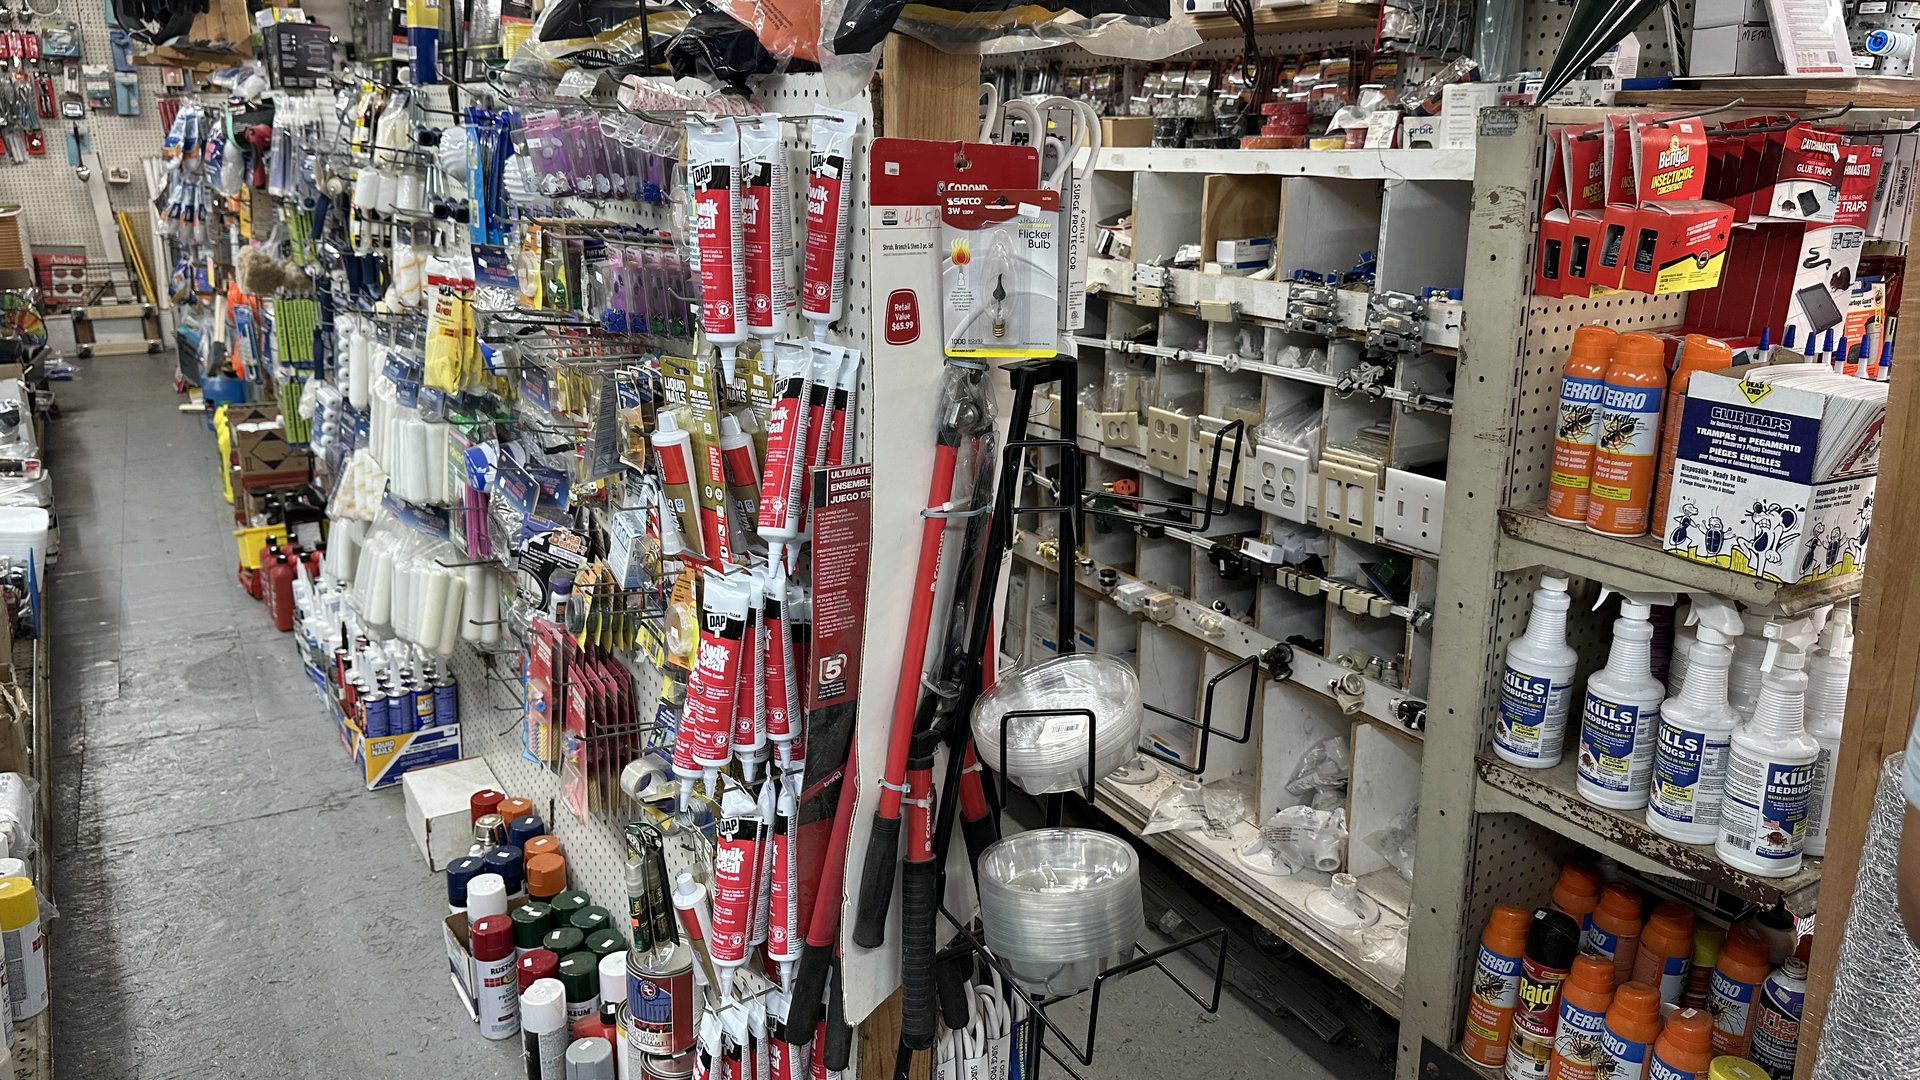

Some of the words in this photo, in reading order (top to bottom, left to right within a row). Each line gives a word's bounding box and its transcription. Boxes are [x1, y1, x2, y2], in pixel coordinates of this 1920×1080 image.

[1659, 144, 1689, 169] Bengal
[695, 167, 711, 183] DAP
[1651, 166, 1694, 190] INSECTICIDE
[1797, 164, 1814, 174] GLUE
[1814, 166, 1832, 177] TRAPS
[953, 197, 981, 206] SATCO
[1072, 184, 1081, 215] SURGE
[1841, 201, 1867, 212] TRAPS
[947, 208, 961, 216] 3W
[1018, 229, 1051, 240] Flicker
[1028, 240, 1051, 250] Bulb
[1070, 215, 1079, 271] PROTECTOR
[894, 303, 911, 312] Retail
[895, 313, 911, 321] Value
[892, 321, 914, 331] $65.99
[951, 338, 966, 346] 1000
[664, 376, 687, 391] LIQUID
[776, 380, 788, 394] DAP
[1560, 379, 1602, 400] TERRO
[1745, 381, 1764, 390] DEAD
[666, 389, 687, 404] NAILS
[1602, 385, 1647, 410] TERRO
[1747, 388, 1761, 396] END
[1560, 402, 1571, 412] Ant
[1572, 405, 1598, 415] Killer
[1602, 411, 1613, 420] Ant
[1614, 413, 1639, 425] Killer
[1711, 407, 1744, 423] GLUE
[1744, 412, 1791, 431] TRAPS
[1696, 427, 1736, 440] TRAMPAS
[1748, 436, 1802, 454] PEGAMENTO
[1681, 463, 1709, 476] Disposable
[1712, 469, 1729, 481] Ready
[1730, 474, 1736, 482] To
[1736, 475, 1747, 484] Use
[830, 493, 859, 505] JUEGO
[860, 491, 871, 499] DE
[709, 615, 726, 628] DAP
[700, 638, 730, 661] Kwik
[700, 652, 726, 673] Seal
[825, 659, 842, 679] 5
[1503, 670, 1545, 696] KILLS
[1503, 684, 1534, 702] EDBUGS
[1587, 698, 1632, 724] KILLS
[371, 740, 395, 750] LIQUID
[372, 747, 393, 757] NAILS
[1602, 760, 1624, 769] CAUTION
[1664, 789, 1687, 799] CAUTION
[1479, 943, 1515, 974] TERRO
[1519, 976, 1556, 1006] Raid
[1764, 1007, 1799, 1031] Flea
[1525, 1022, 1549, 1034] Roach
[1561, 1023, 1588, 1042] Spider
[990, 1045, 999, 1065] SURGE
